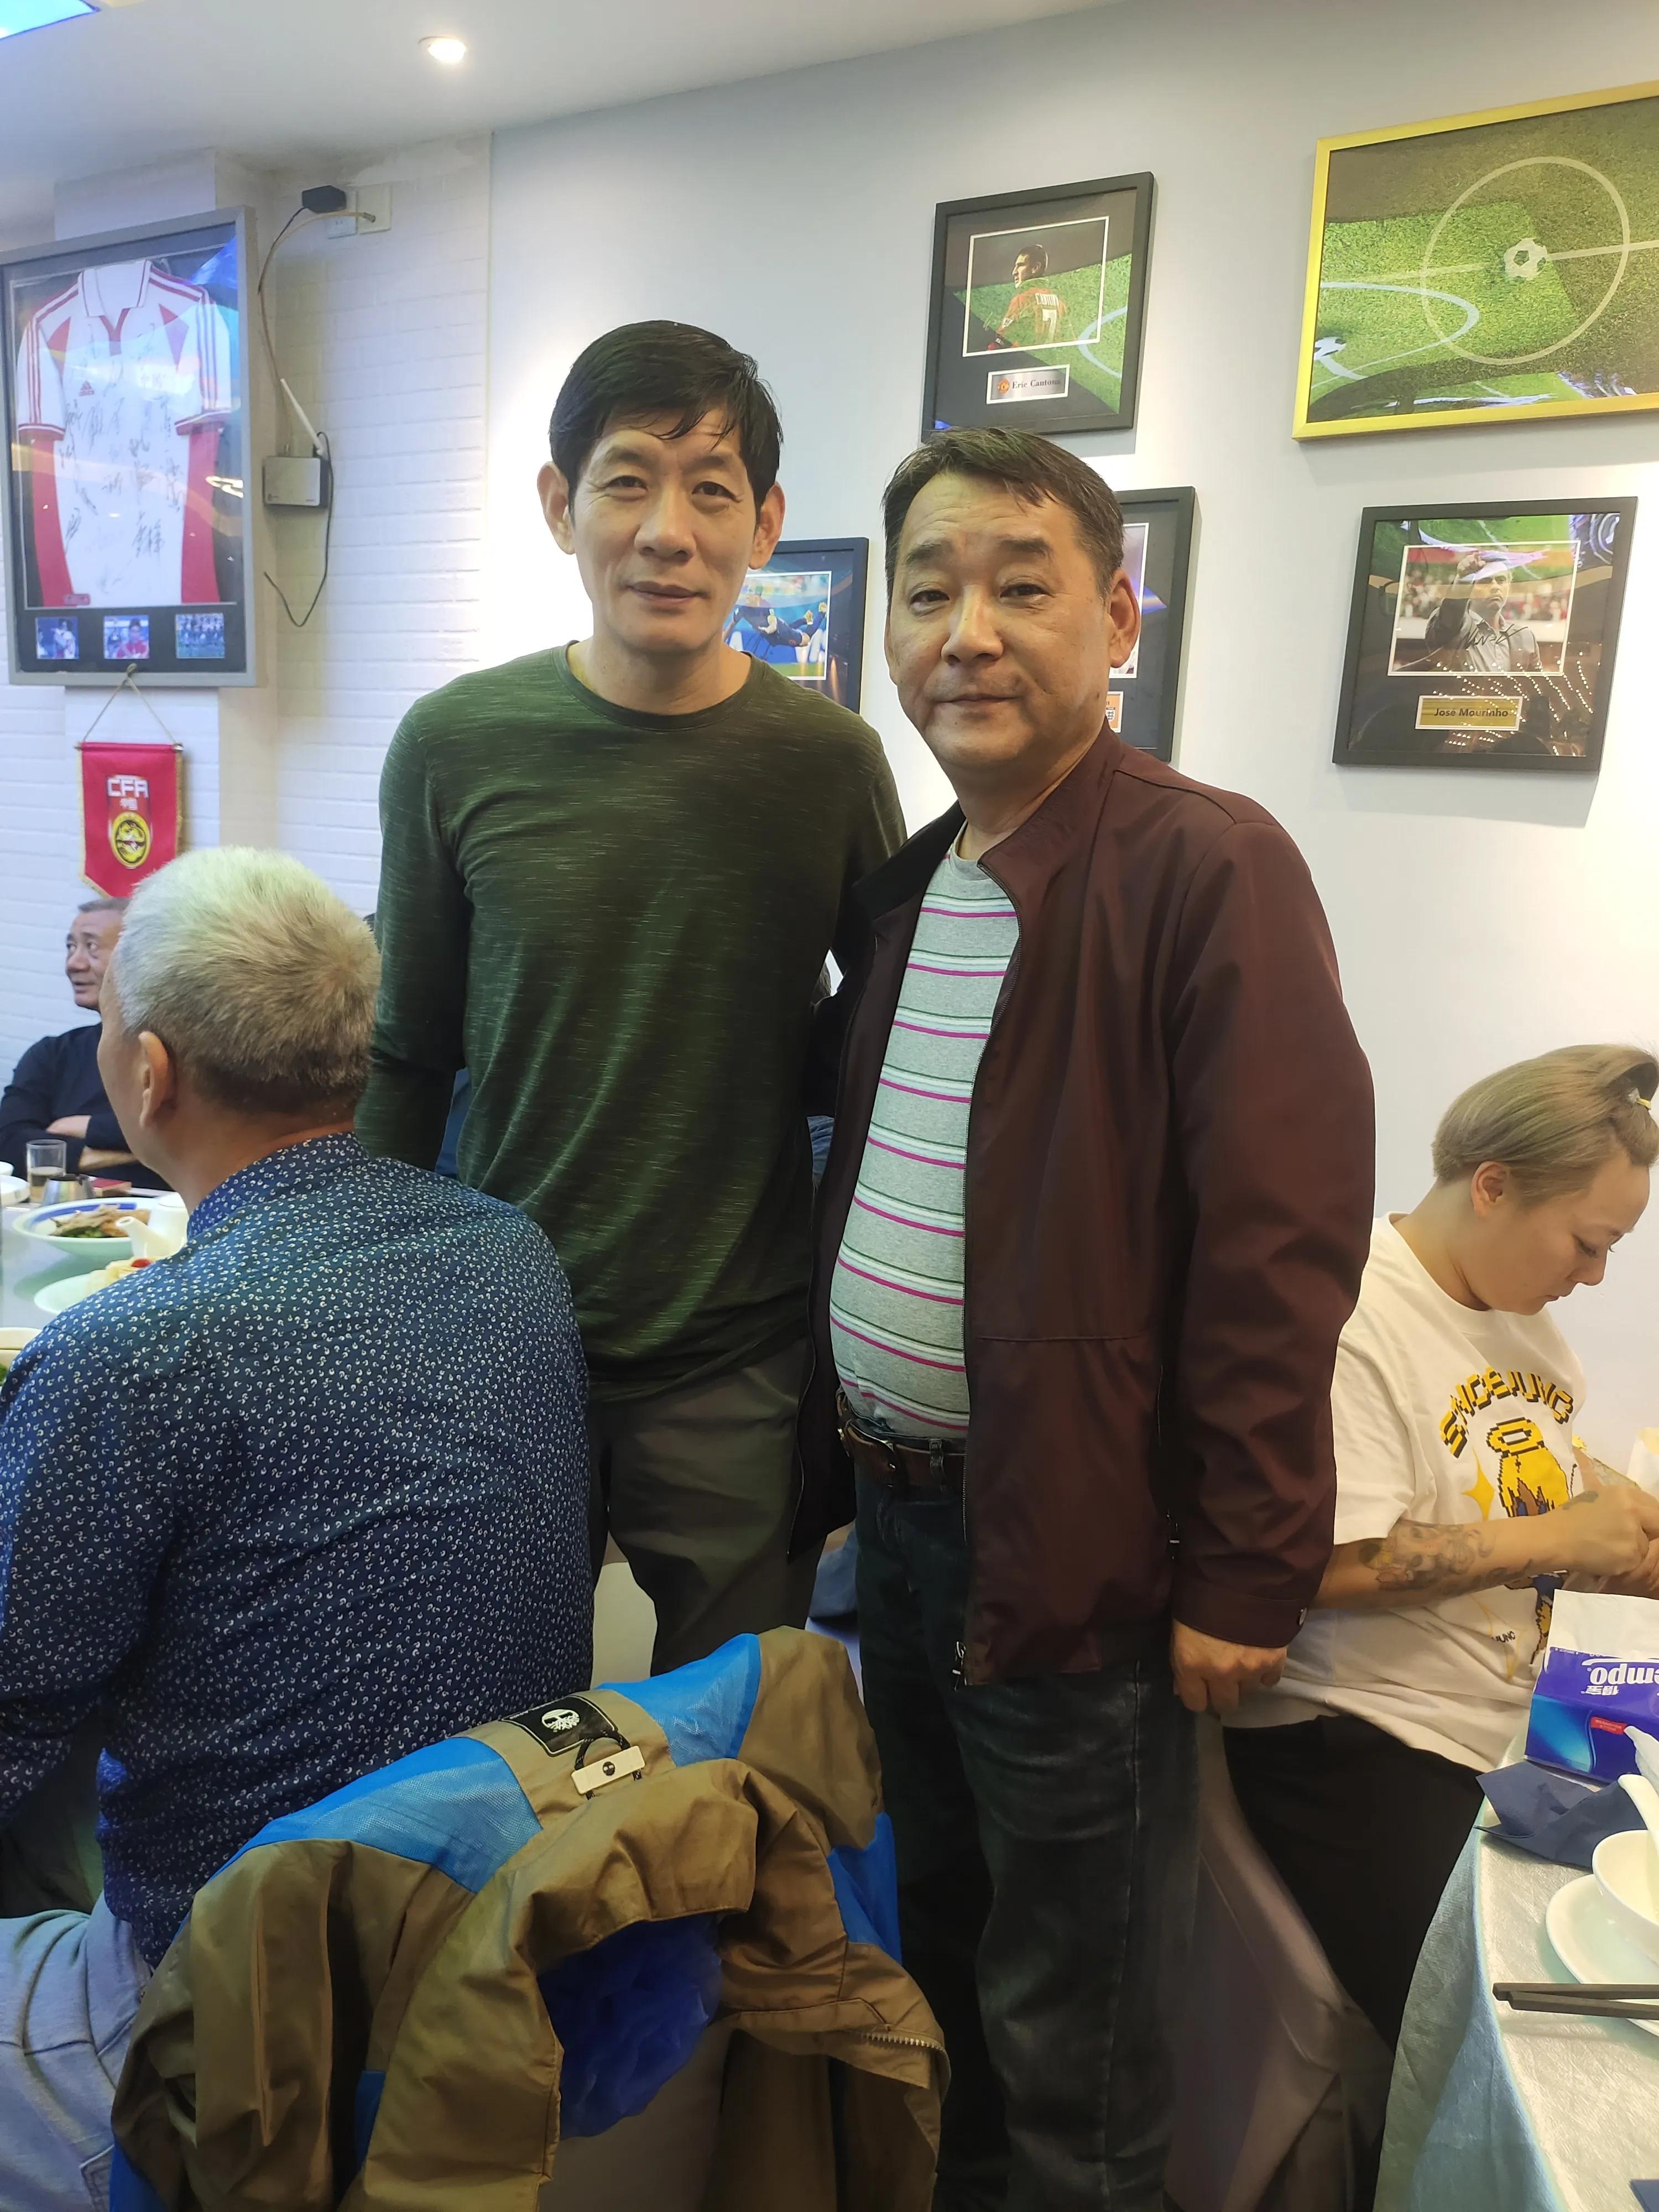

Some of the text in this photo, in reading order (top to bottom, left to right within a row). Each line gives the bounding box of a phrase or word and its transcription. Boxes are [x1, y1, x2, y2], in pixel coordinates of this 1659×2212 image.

[1030, 379, 1061, 387] Cantona
[1434, 708, 1508, 717] José Mourinho
[107, 778, 149, 798] CFA
